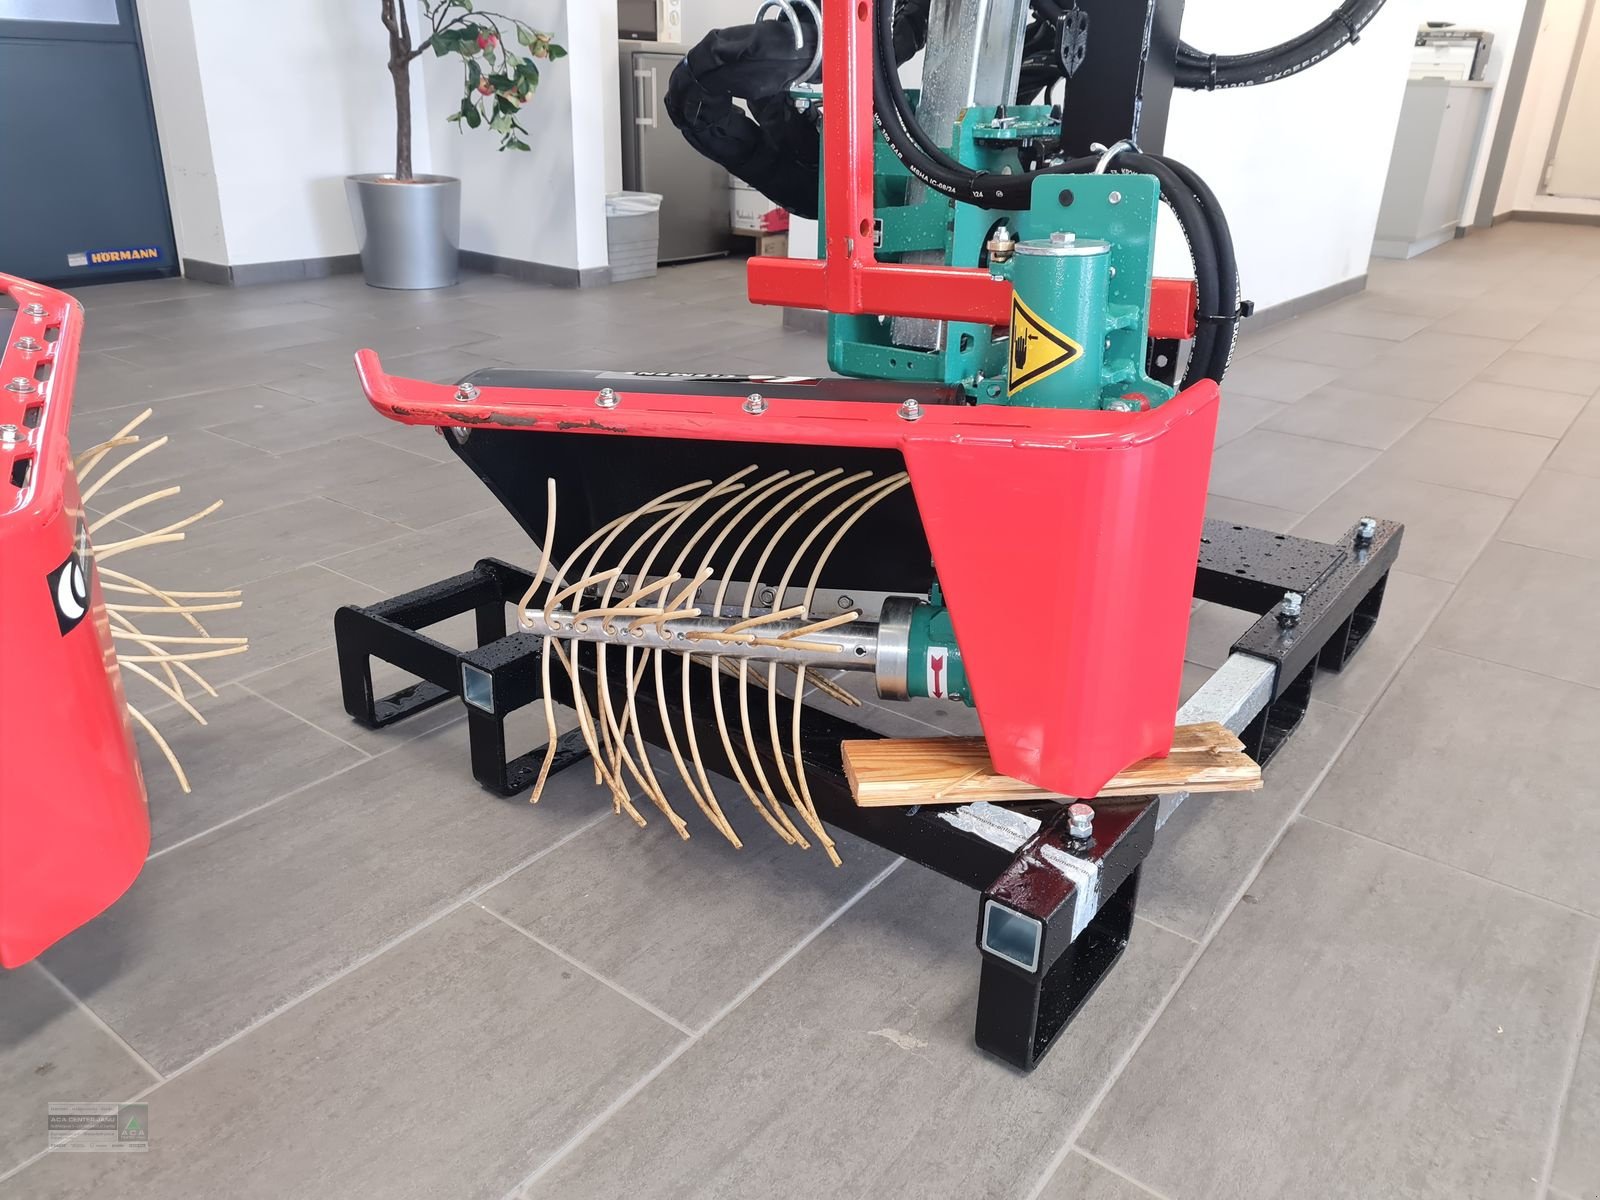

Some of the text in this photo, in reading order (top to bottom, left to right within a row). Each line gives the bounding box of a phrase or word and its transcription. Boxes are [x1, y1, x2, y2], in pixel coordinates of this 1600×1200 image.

[1264, 49, 1329, 82] EXCEEDS
[890, 143, 903, 159] BAR
[909, 165, 929, 182] MSHA
[91, 248, 158, 263] HÖRMANN
